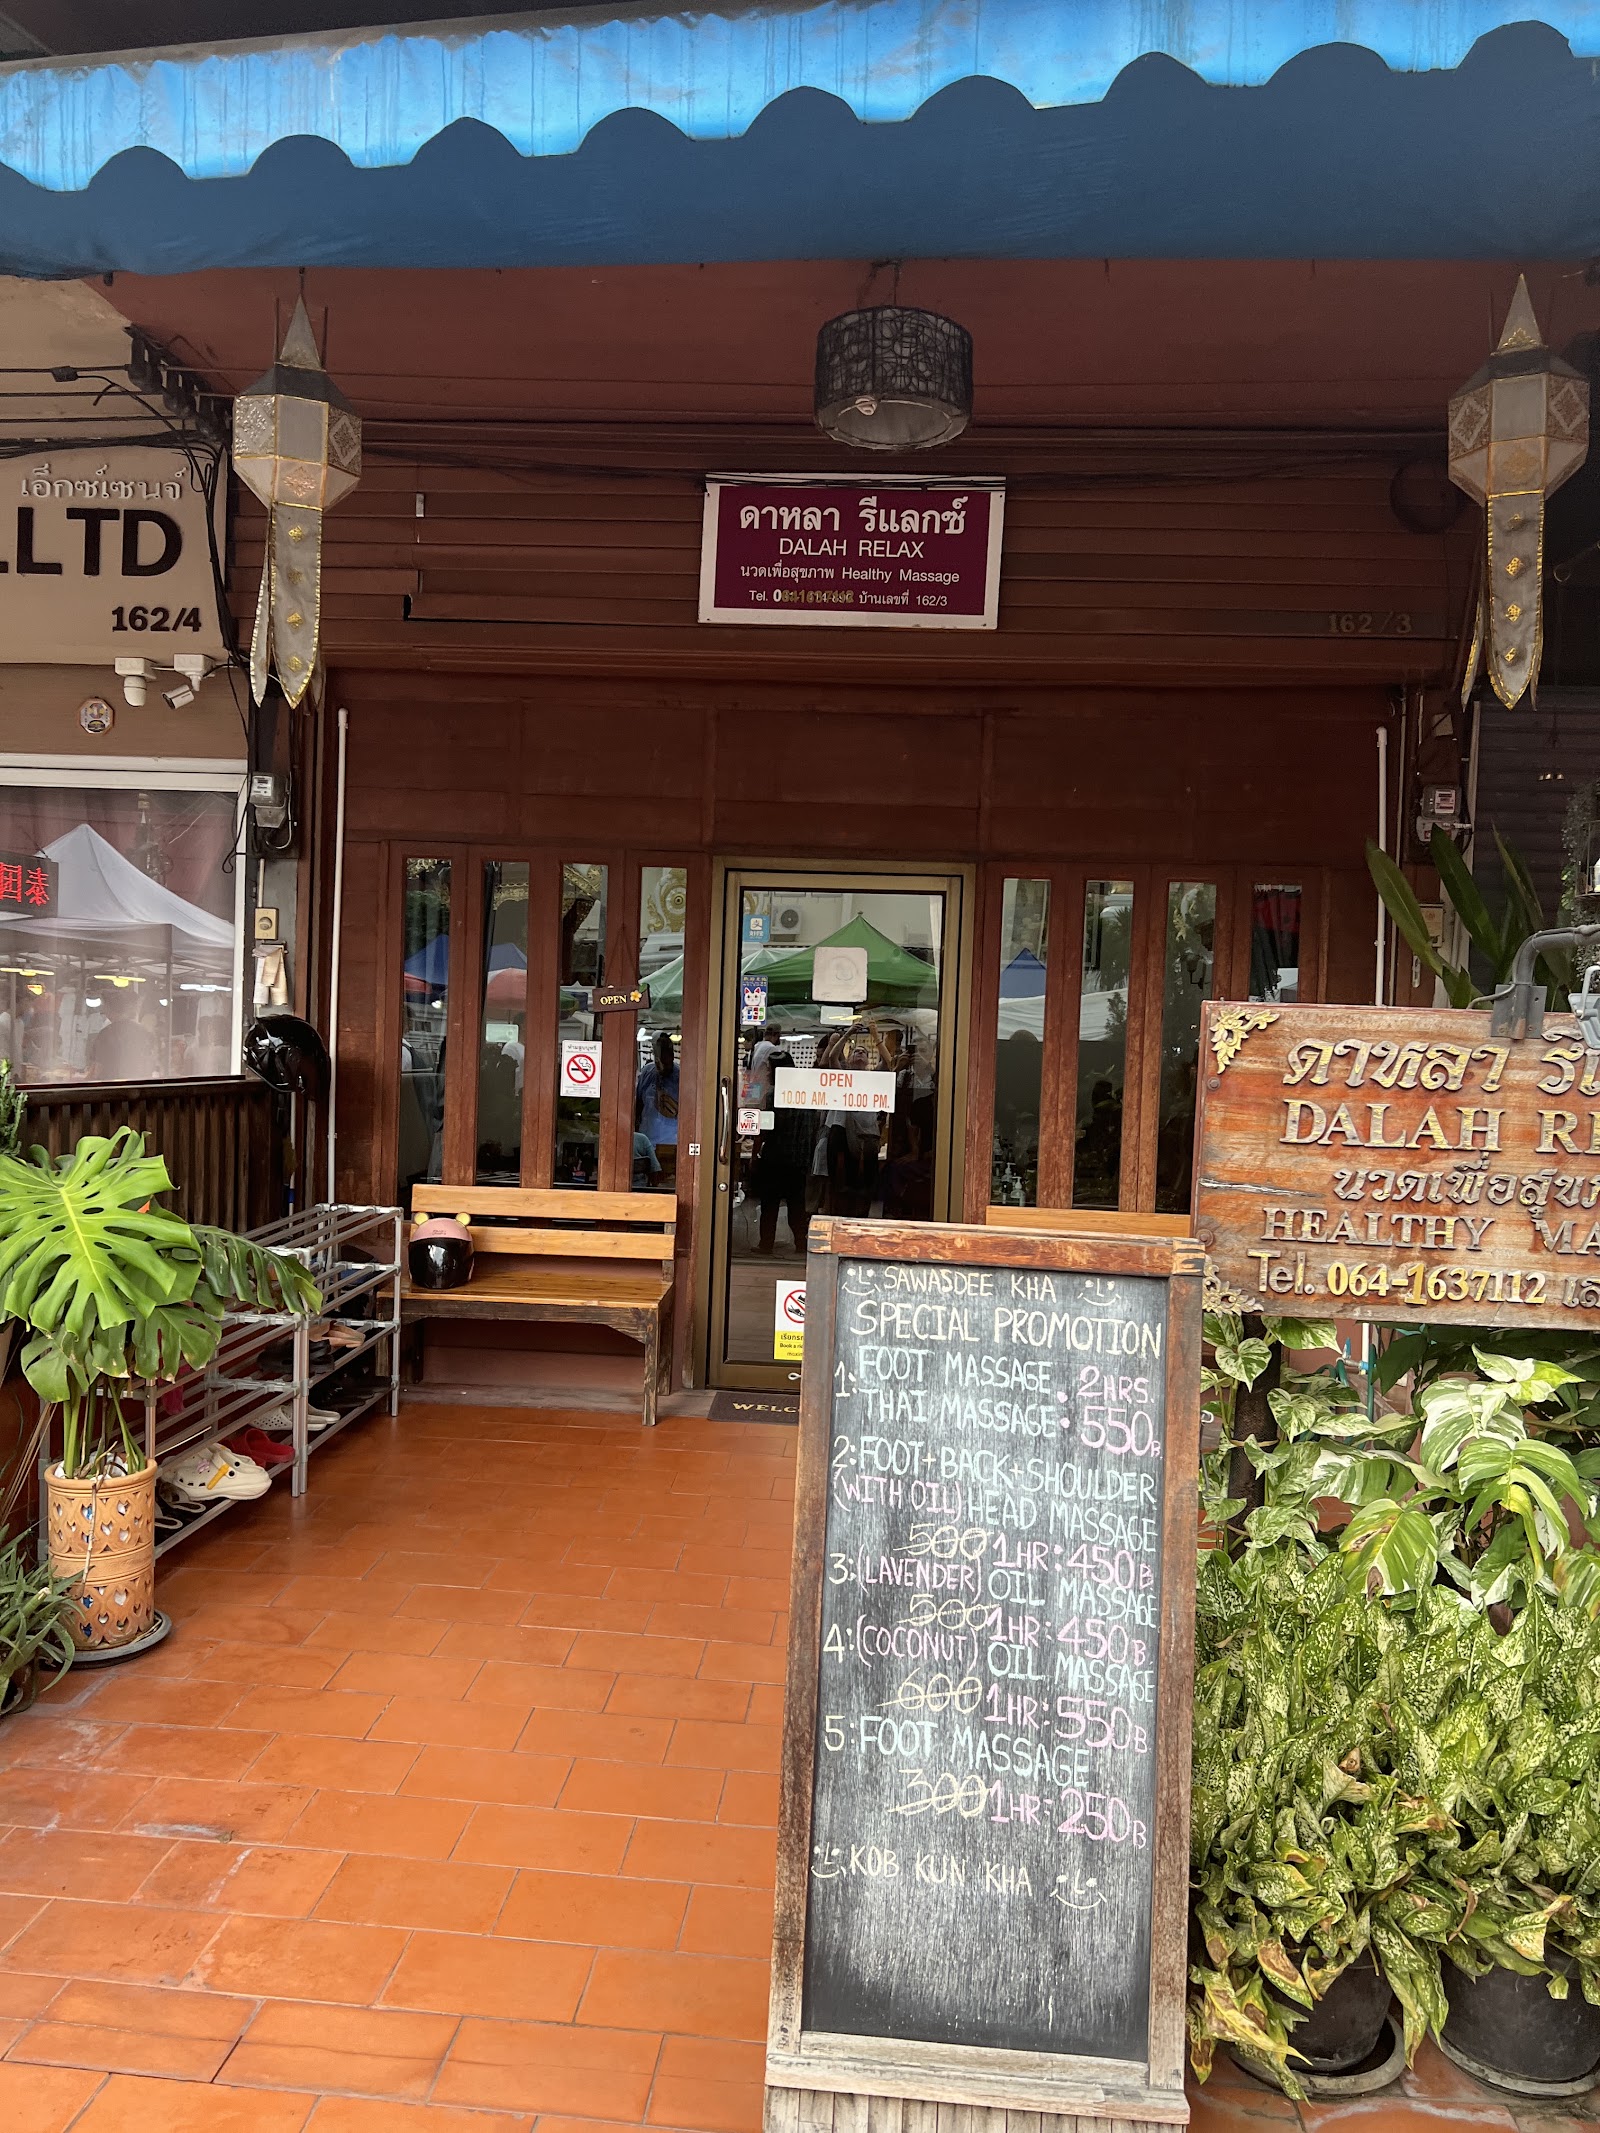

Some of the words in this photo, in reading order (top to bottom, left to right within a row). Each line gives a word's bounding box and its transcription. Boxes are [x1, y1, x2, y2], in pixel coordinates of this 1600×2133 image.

[739, 505, 840, 531] ดาหลา
[858, 496, 969, 535] รีแลกซ์
[779, 538, 847, 557] DALAH
[858, 540, 924, 558] RELAX
[740, 559, 834, 583] นวดเพื่อสุขภาพ
[842, 567, 892, 583] Healthy
[899, 569, 960, 583] Massage
[749, 590, 769, 602] Tel.
[859, 588, 909, 605] บ้านเลขที่
[915, 594, 948, 606] 162/3
[111, 606, 202, 632] 162/4
[600, 995, 627, 1005] OPEN
[820, 1072, 853, 1088] OPEN
[1282, 1038, 1510, 1093] ดาหลา
[781, 1090, 806, 1105] 10.00
[811, 1091, 828, 1106] AM.
[842, 1093, 868, 1108] 10.00
[873, 1094, 890, 1109] PM.
[1279, 1098, 1505, 1153] DALAH
[1261, 1206, 1495, 1251] HEALTHY
[884, 1266, 993, 1297] SAWASDEE
[1011, 1274, 1057, 1303] KHA
[1247, 1249, 1316, 1296] Tel.
[1326, 1261, 1547, 1306] 064-1637112
[850, 1300, 980, 1342] SPECIAL
[994, 1307, 1162, 1359] PROMOTION
[858, 1346, 935, 1383] FOOT
[732, 1402, 800, 1413] WELC
[859, 1389, 929, 1423] THAI
[968, 1487, 1036, 1530] HEAD
[1049, 1500, 1158, 1552] MASSAGE
[988, 1570, 1045, 1606] OIL
[1058, 1577, 1157, 1628] MASSAGE
[987, 1642, 1047, 1680] OIL
[1054, 1651, 1155, 1703] MASSAGE
[860, 1716, 938, 1757] FOOT
[950, 1724, 1090, 1788] MASSAGE
[850, 1843, 899, 1878] KOB
[916, 1854, 966, 1887] KUN
[985, 1860, 1033, 1897] KHA
